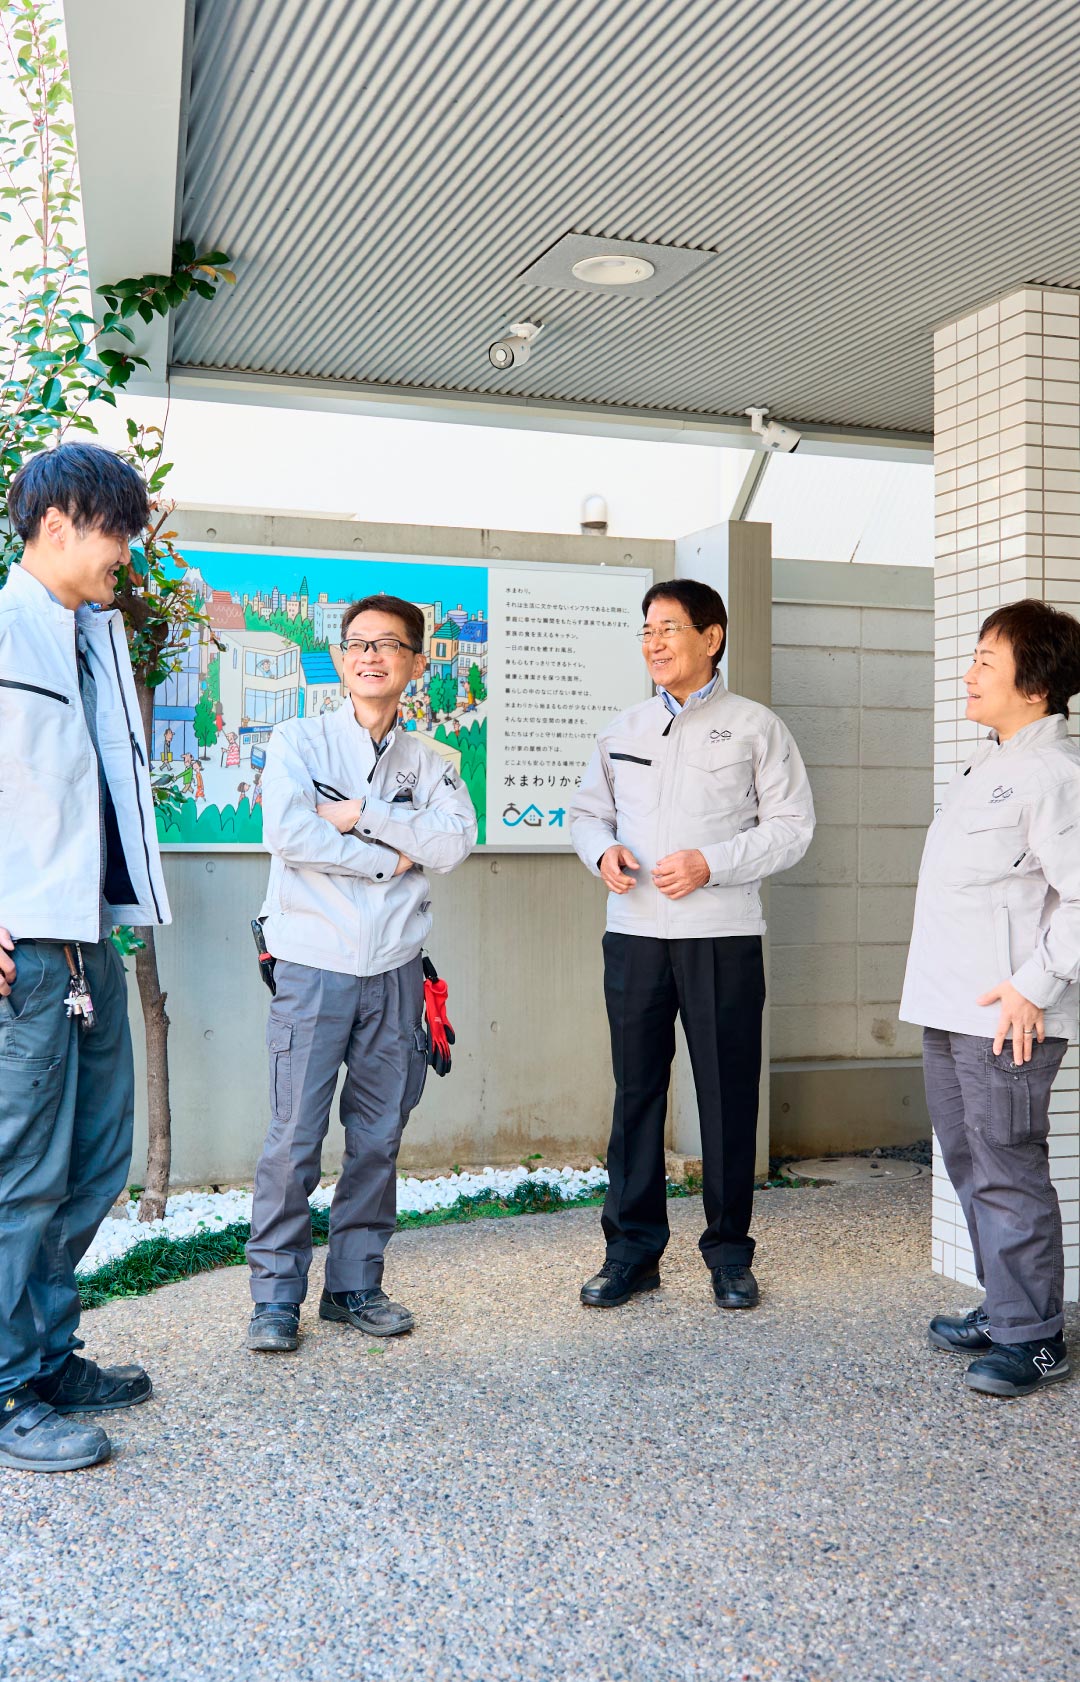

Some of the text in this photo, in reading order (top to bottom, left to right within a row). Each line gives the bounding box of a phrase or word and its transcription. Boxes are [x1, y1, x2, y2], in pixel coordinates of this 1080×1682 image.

[505, 587, 531, 595] 水まわり。
[505, 759, 588, 769] どこよりも安心できる場所であ
[548, 808, 567, 827] オ
[1033, 1347, 1055, 1375] N
